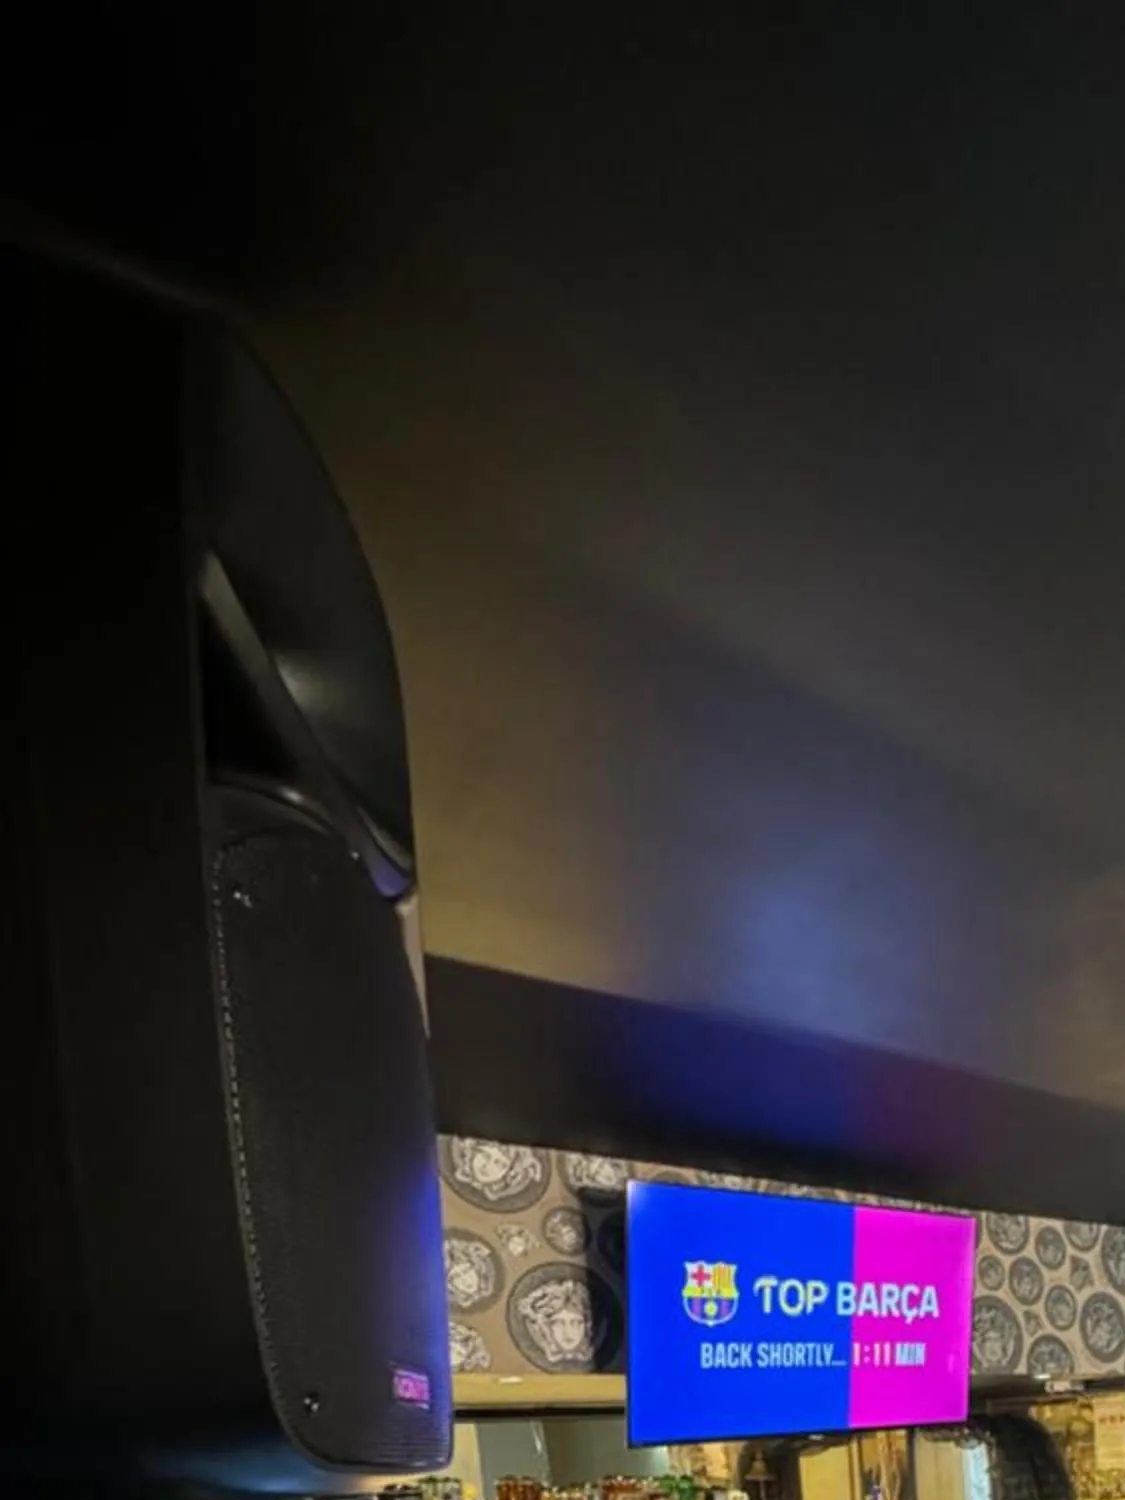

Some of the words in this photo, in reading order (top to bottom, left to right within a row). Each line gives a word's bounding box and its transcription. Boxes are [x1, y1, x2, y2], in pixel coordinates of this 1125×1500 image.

[753, 1275, 830, 1317] TOP
[836, 1281, 940, 1324] BARÇA
[701, 1342, 753, 1369] BACK
[852, 1342, 892, 1367] 1:11
